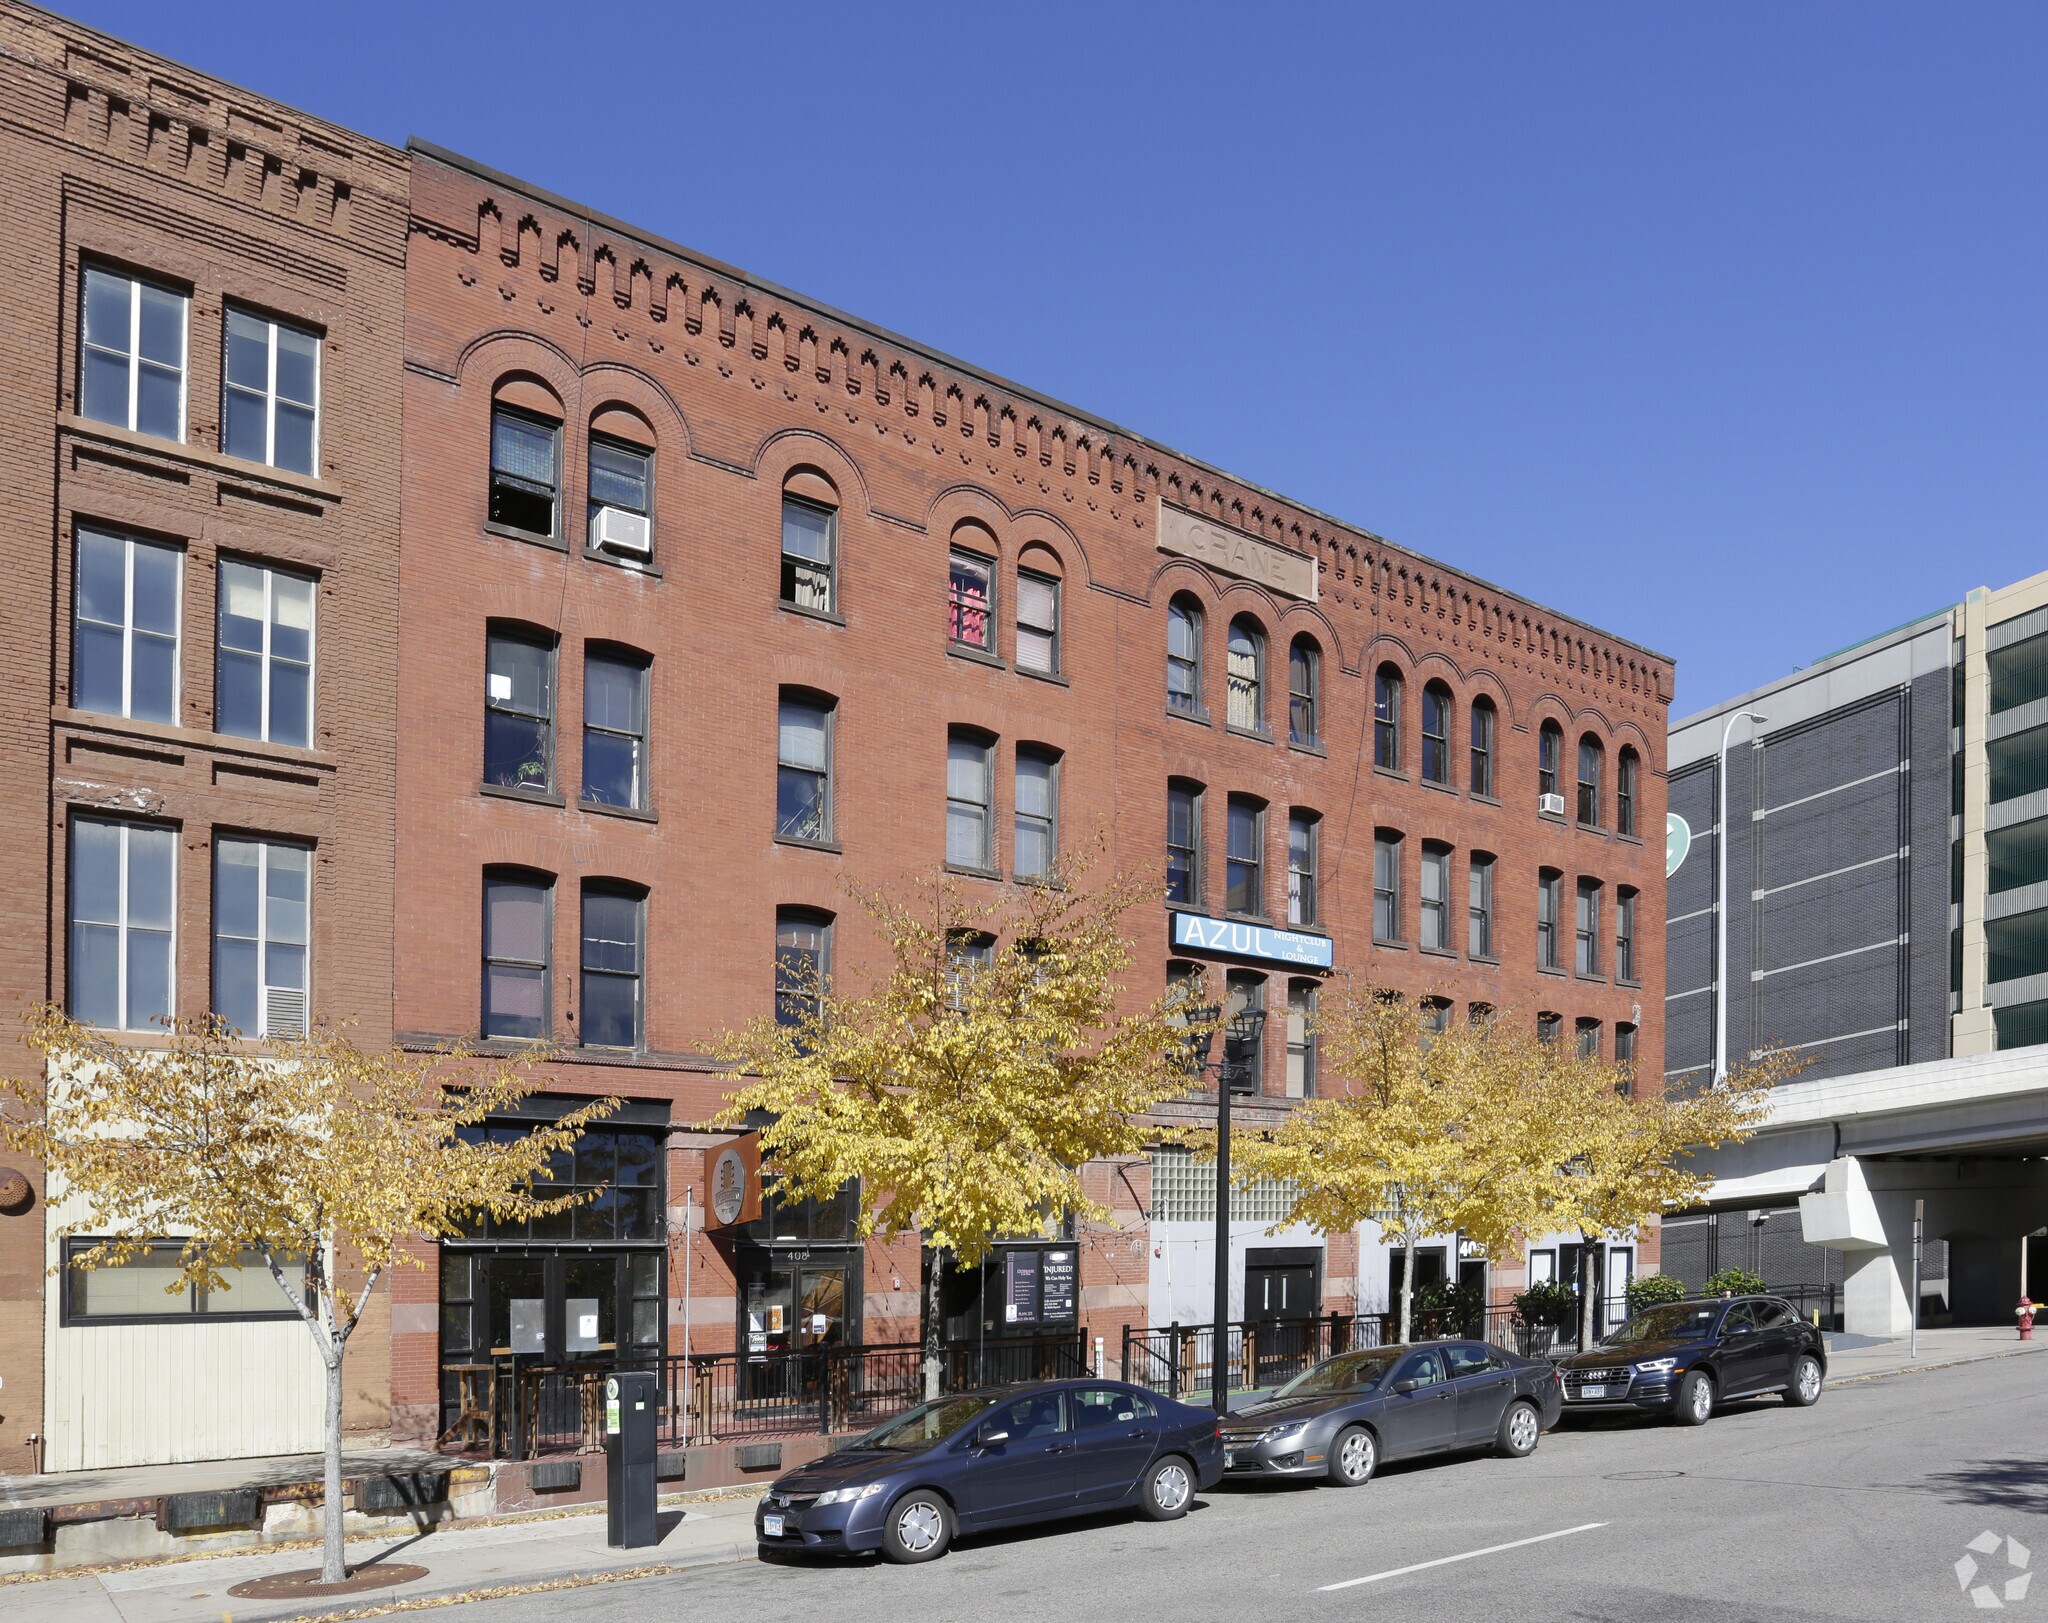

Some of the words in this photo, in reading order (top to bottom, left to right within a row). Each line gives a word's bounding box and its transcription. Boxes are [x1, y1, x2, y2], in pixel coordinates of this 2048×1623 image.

[1188, 523, 1287, 583] CRANE
[1183, 916, 1273, 957] AZUL
[1273, 930, 1327, 948] NIGHTCLUB
[1296, 944, 1304, 953] &
[1281, 951, 1319, 964] LOUNGE
[787, 1251, 808, 1261] 408
